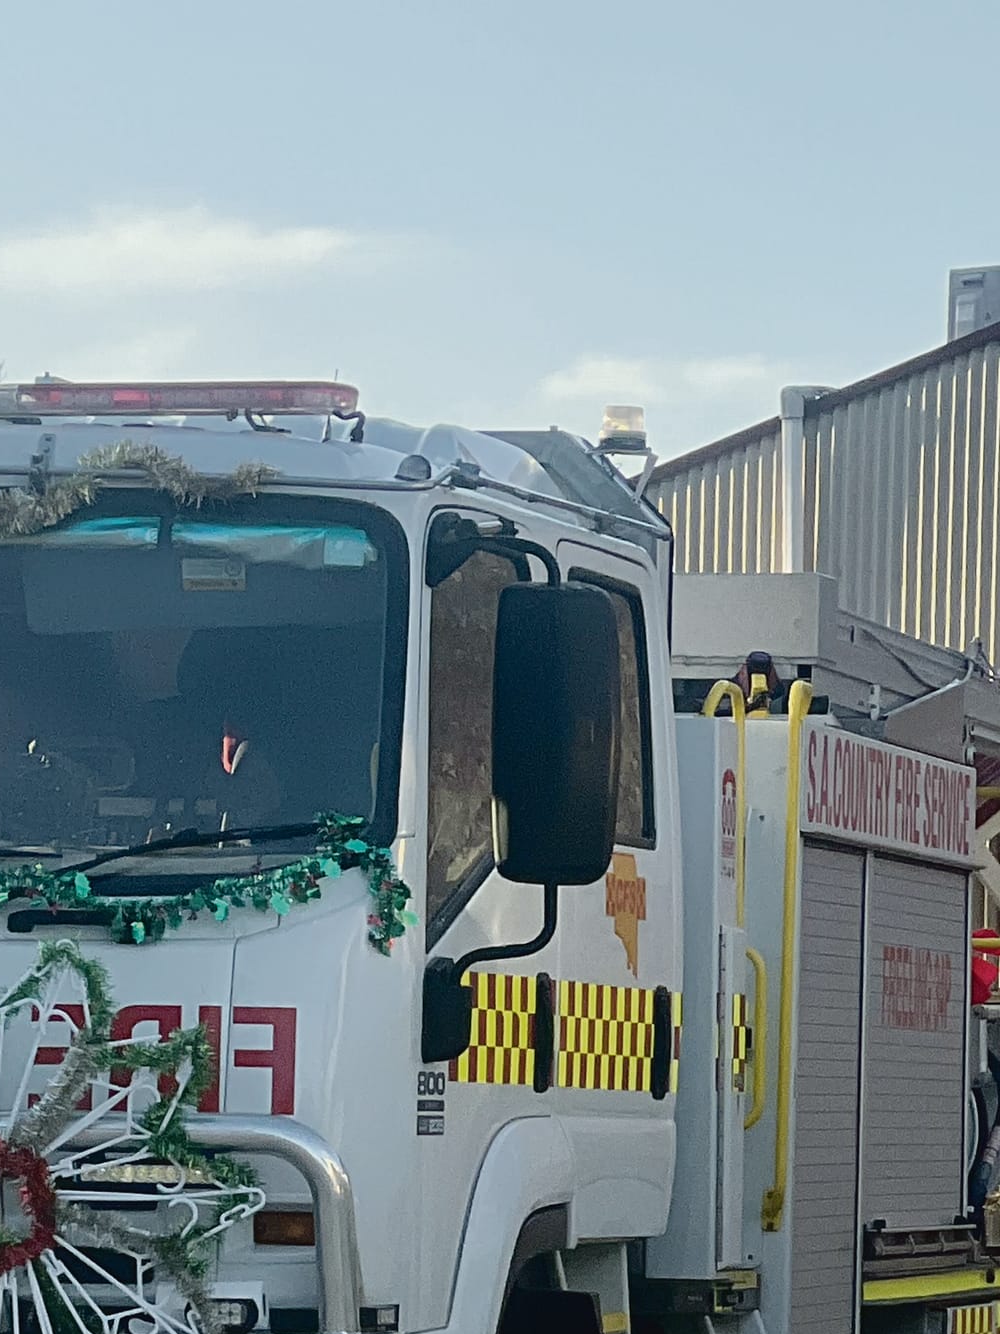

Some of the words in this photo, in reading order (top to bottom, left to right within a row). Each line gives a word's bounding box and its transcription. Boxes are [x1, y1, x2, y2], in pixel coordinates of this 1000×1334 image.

[894, 754, 921, 845] FIRE
[923, 762, 970, 857] SERVICE
[417, 1071, 446, 1096] 800
